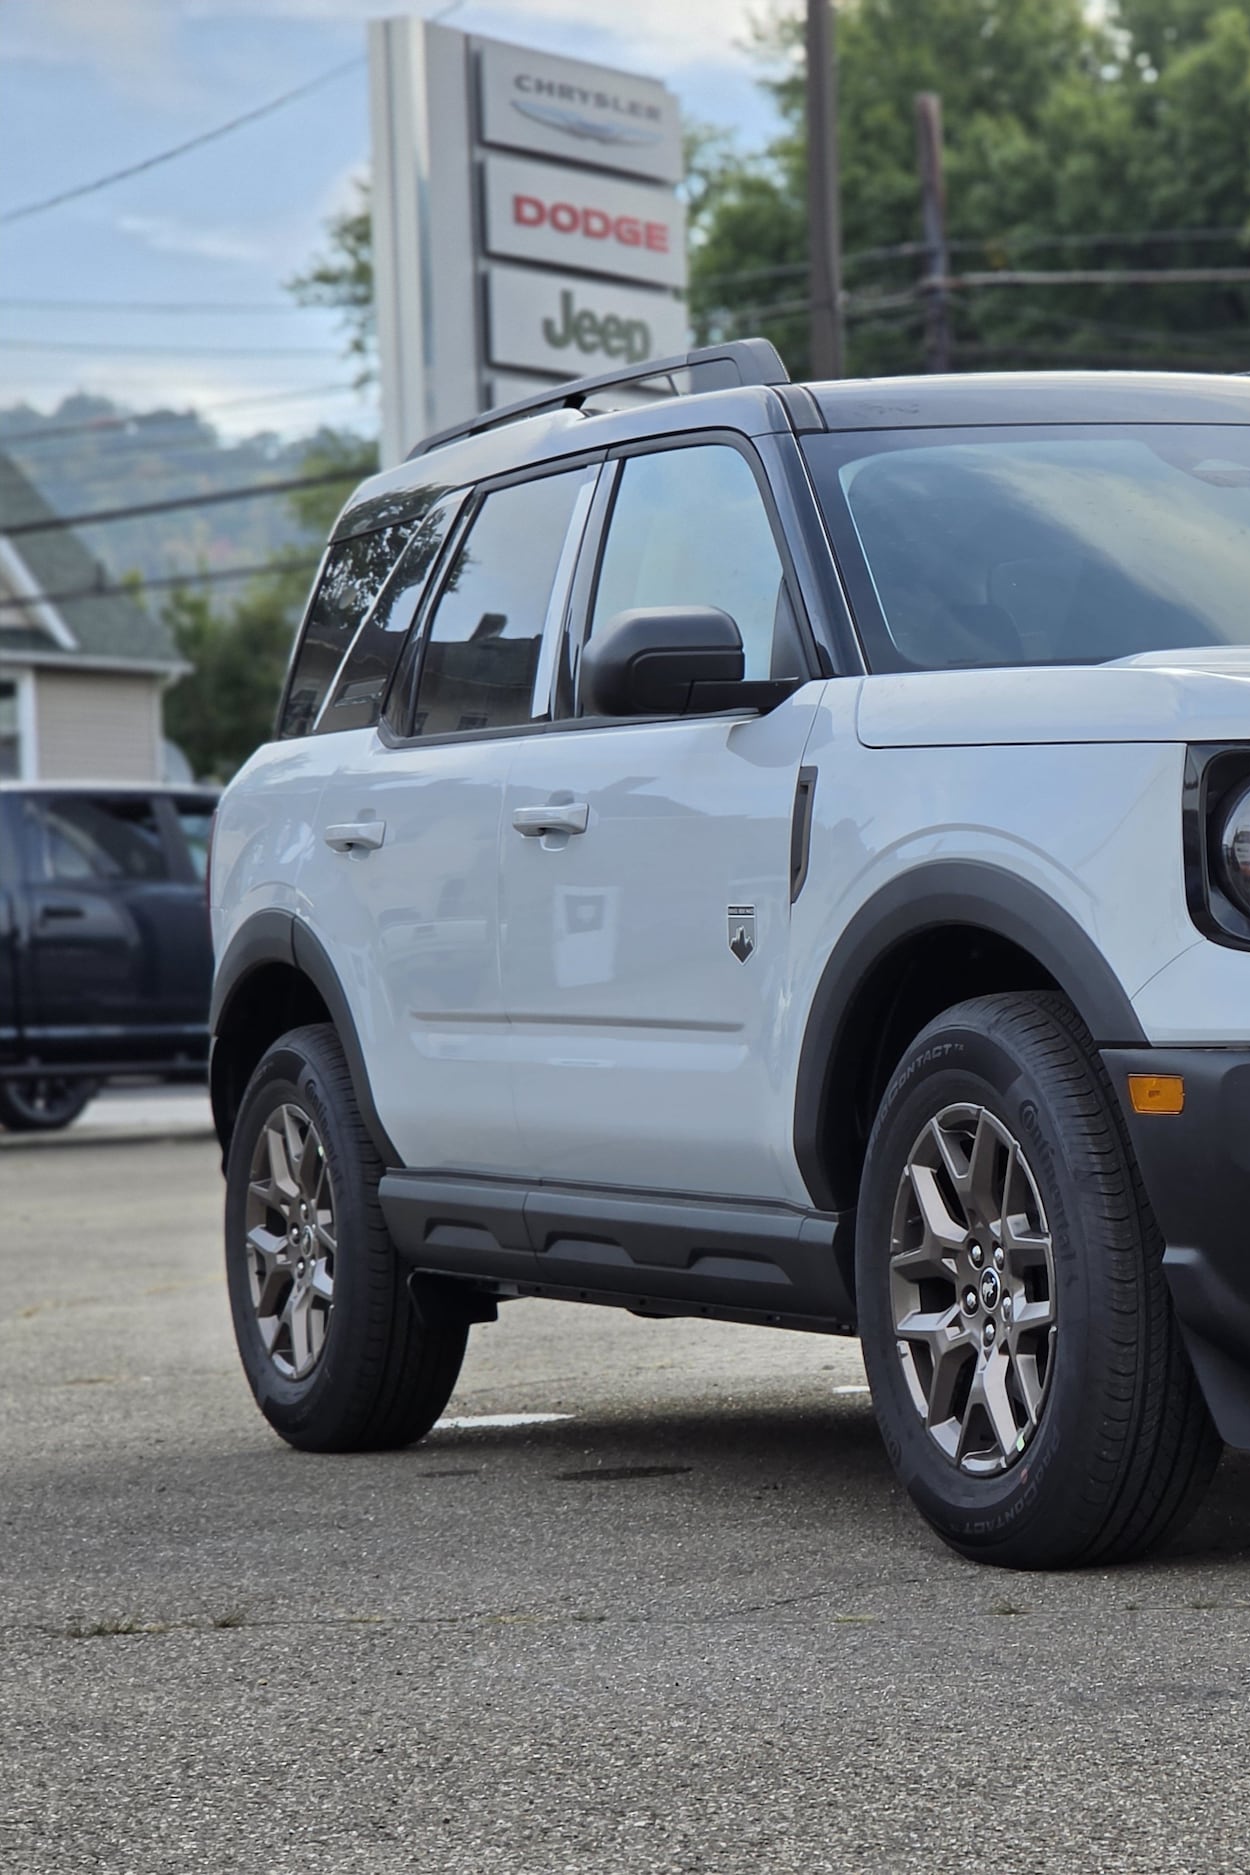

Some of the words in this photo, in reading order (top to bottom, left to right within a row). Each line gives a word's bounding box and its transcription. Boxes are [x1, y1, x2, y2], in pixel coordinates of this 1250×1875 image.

[512, 74, 662, 122] CHRYSLER
[512, 194, 670, 253] DODGE
[542, 289, 652, 364] Jeep
